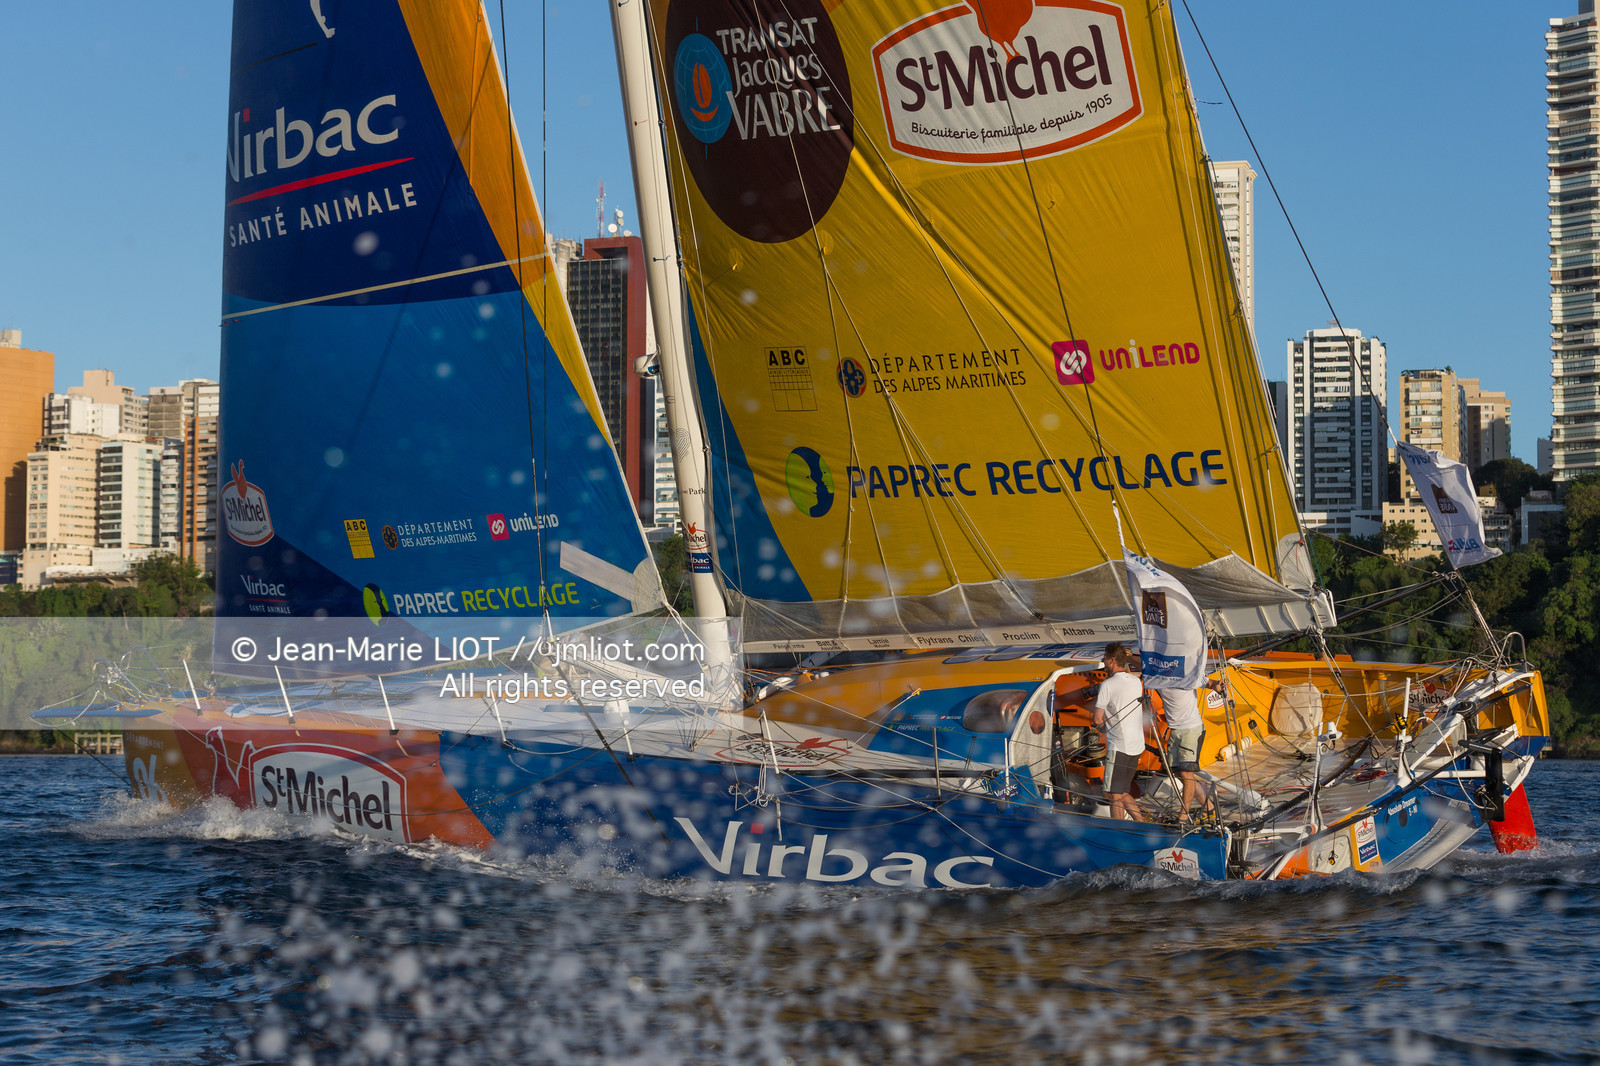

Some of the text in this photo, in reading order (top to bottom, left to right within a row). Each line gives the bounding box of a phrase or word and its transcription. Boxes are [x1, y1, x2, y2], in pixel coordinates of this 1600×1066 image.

[716, 17, 818, 55] TRANSAT
[731, 53, 822, 98] Jacques
[726, 86, 841, 140] VABRE
[911, 94, 1113, 143] Biscuiterie familiale depuis 1905
[227, 94, 399, 182] Virbac
[229, 182, 418, 247] SANTÉ ANIMALE
[769, 349, 805, 366] ABC
[869, 348, 1020, 374] DÉPARTEMENT
[873, 370, 1027, 394] DES ALPES MARITIMES
[846, 449, 1228, 499] PAPREC RECYCLAGE
[346, 520, 367, 531] ABC
[397, 519, 473, 536] DÉPARTEMENT
[401, 538, 414, 548] DES
[240, 574, 286, 597] Virbac
[393, 582, 580, 615] PAPREC RECYCLAGE
[917, 636, 954, 646] Flytrans
[1002, 632, 1041, 641] Proclim
[1063, 627, 1095, 636] Altana
[673, 817, 994, 888] Virbac
